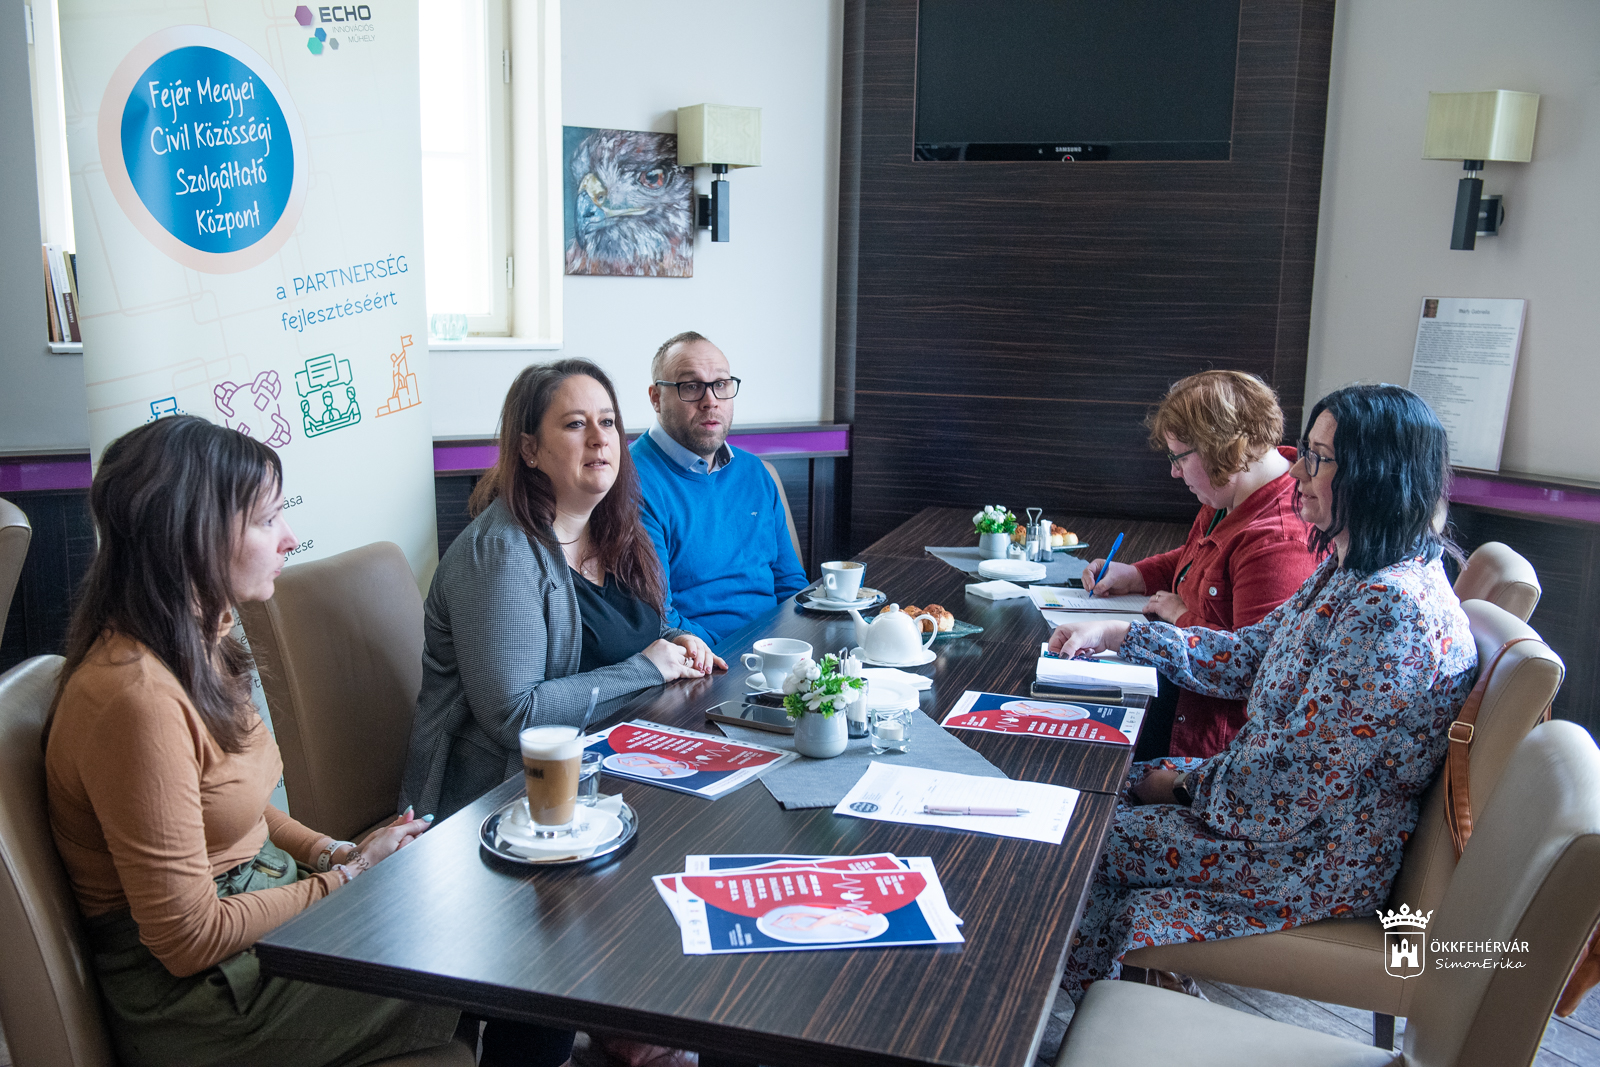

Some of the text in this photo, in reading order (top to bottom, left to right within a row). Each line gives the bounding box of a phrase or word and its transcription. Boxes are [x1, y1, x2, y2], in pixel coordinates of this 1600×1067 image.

[318, 5, 372, 23] ECHO
[332, 24, 375, 33] INNOVÁCIÓS
[347, 34, 376, 43] MŰHELY
[149, 76, 255, 124] Fejér Megyei
[150, 116, 272, 157] Civil Közösségi
[175, 157, 267, 206] Szolgáltató
[195, 200, 260, 239] Központ
[276, 253, 409, 300] a PARTNERSÉG
[281, 291, 398, 333] fejlesztéséért
[282, 495, 303, 509] ása
